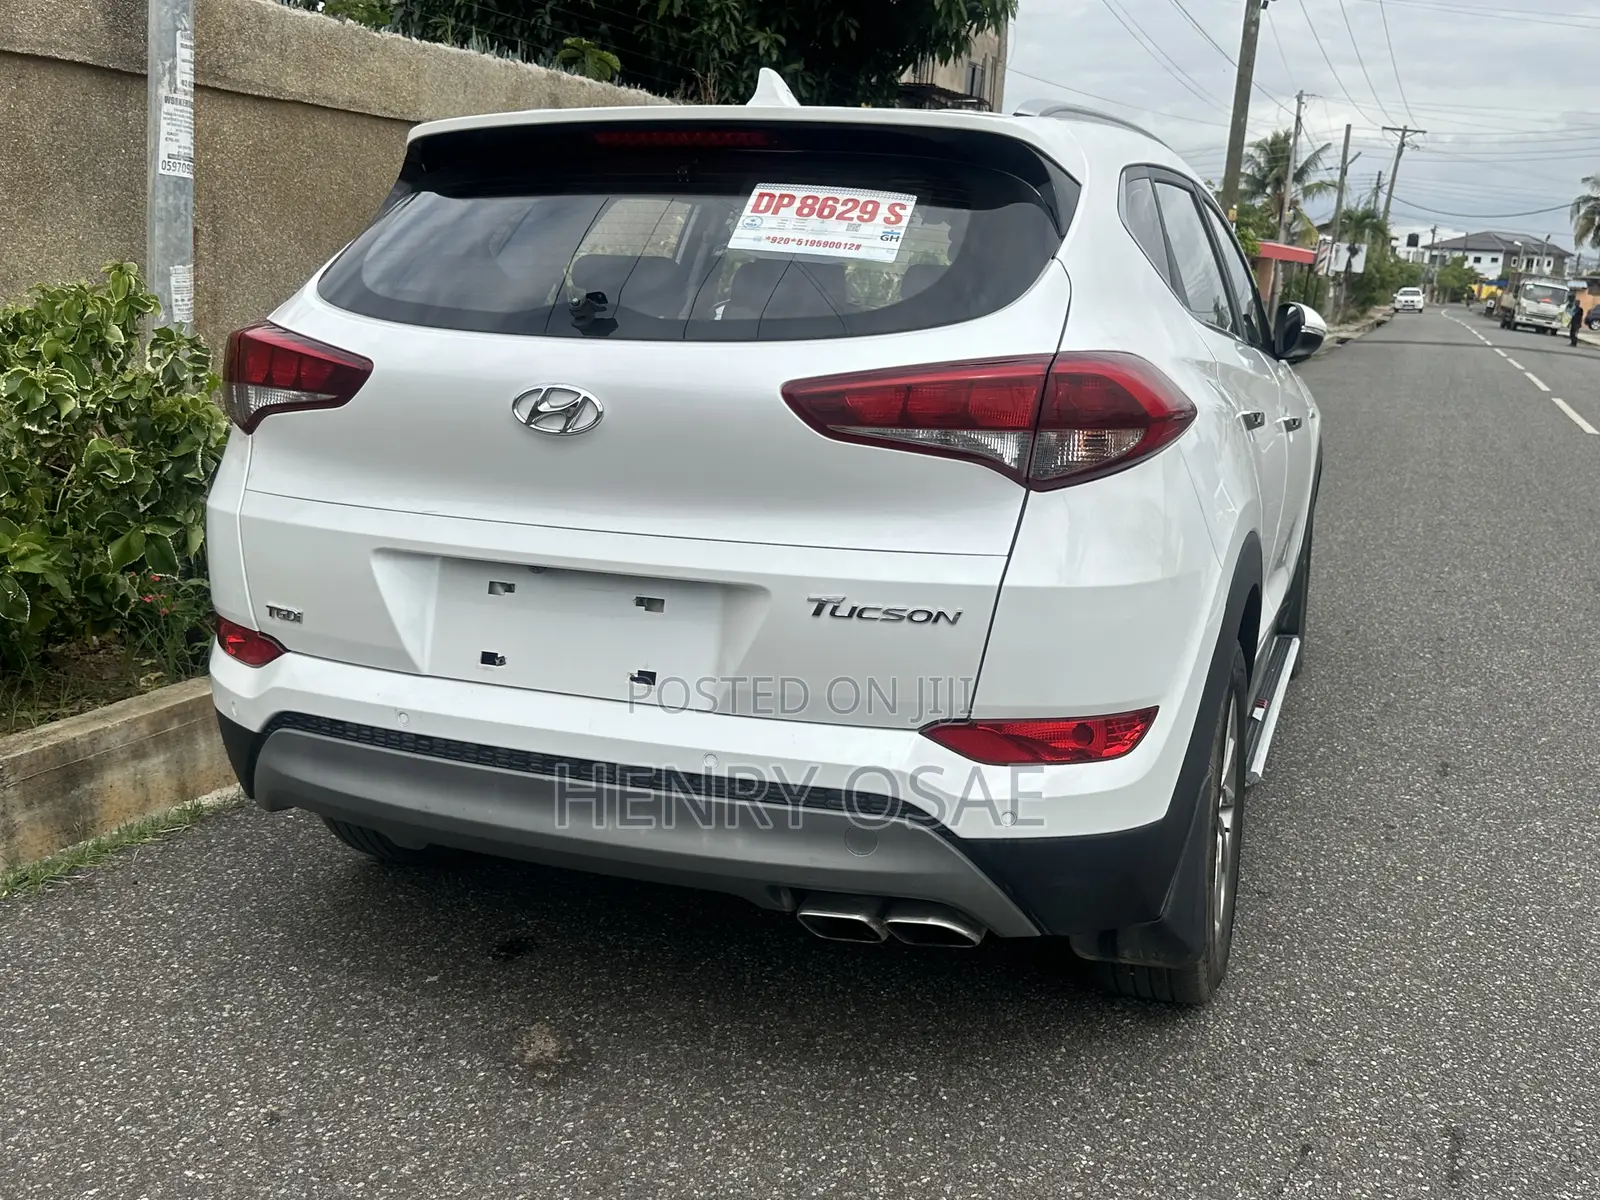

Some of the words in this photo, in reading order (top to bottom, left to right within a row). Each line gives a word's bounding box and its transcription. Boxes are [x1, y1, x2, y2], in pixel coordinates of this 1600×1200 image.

[750, 192, 796, 215] DP
[795, 195, 880, 223] 8629
[883, 202, 907, 225] S
[880, 234, 900, 243] GH
[807, 596, 963, 625] TUCSON
